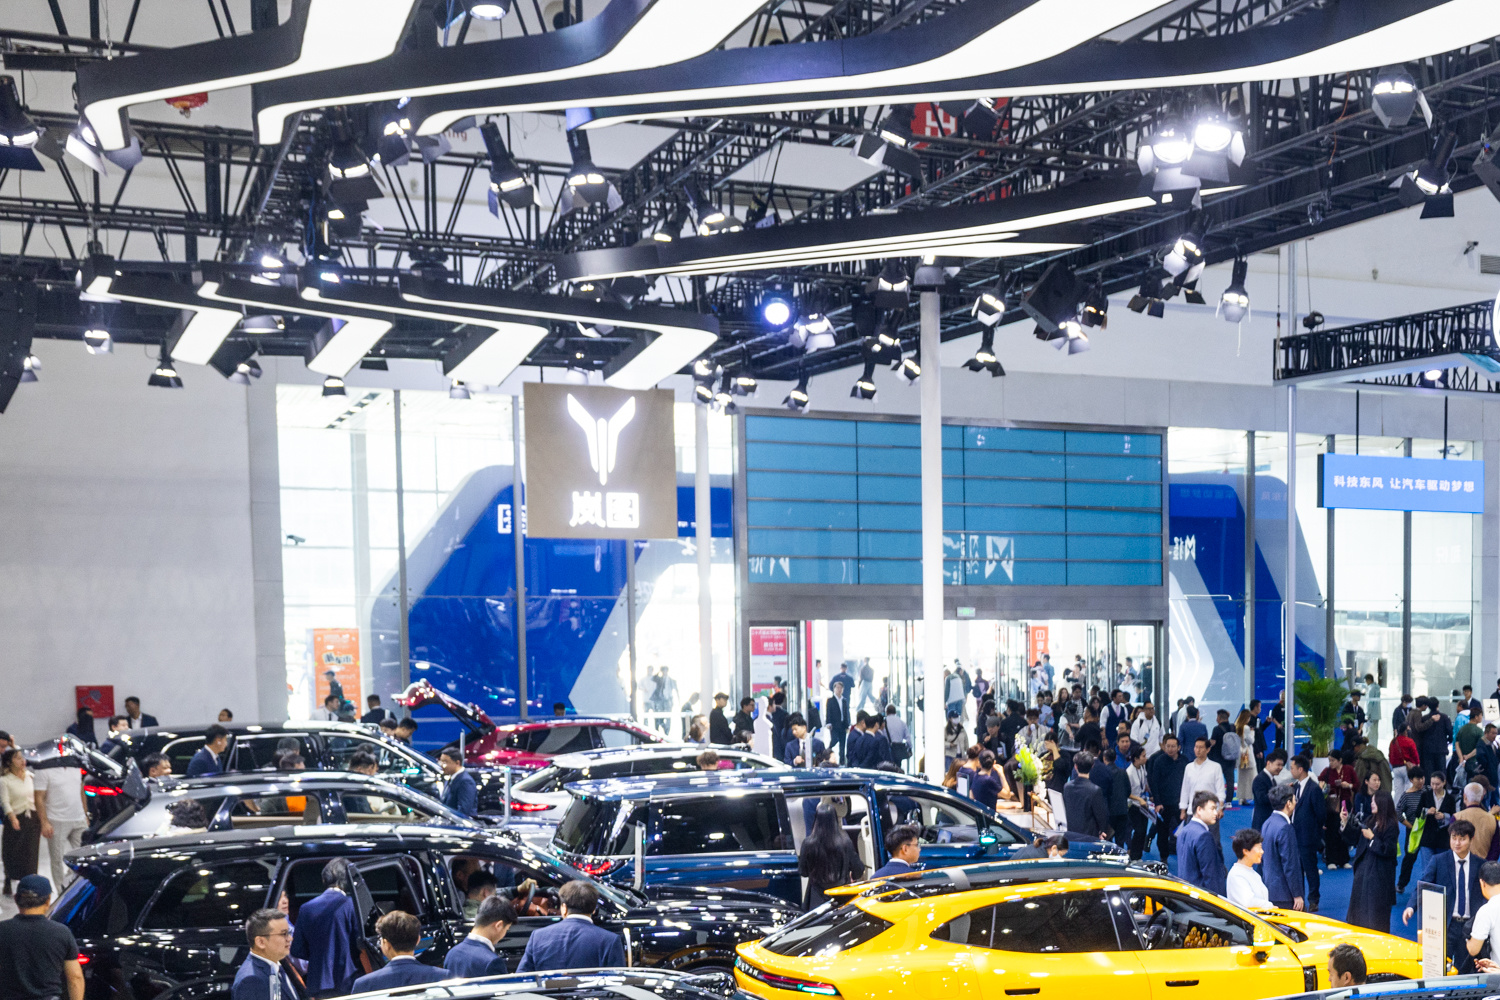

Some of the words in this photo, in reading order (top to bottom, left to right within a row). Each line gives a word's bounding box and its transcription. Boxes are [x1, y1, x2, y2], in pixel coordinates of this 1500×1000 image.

[1334, 475, 1384, 489] 科技东风
[1389, 477, 1475, 493] 让汽车驱动梦想
[569, 490, 640, 529] 岚图
